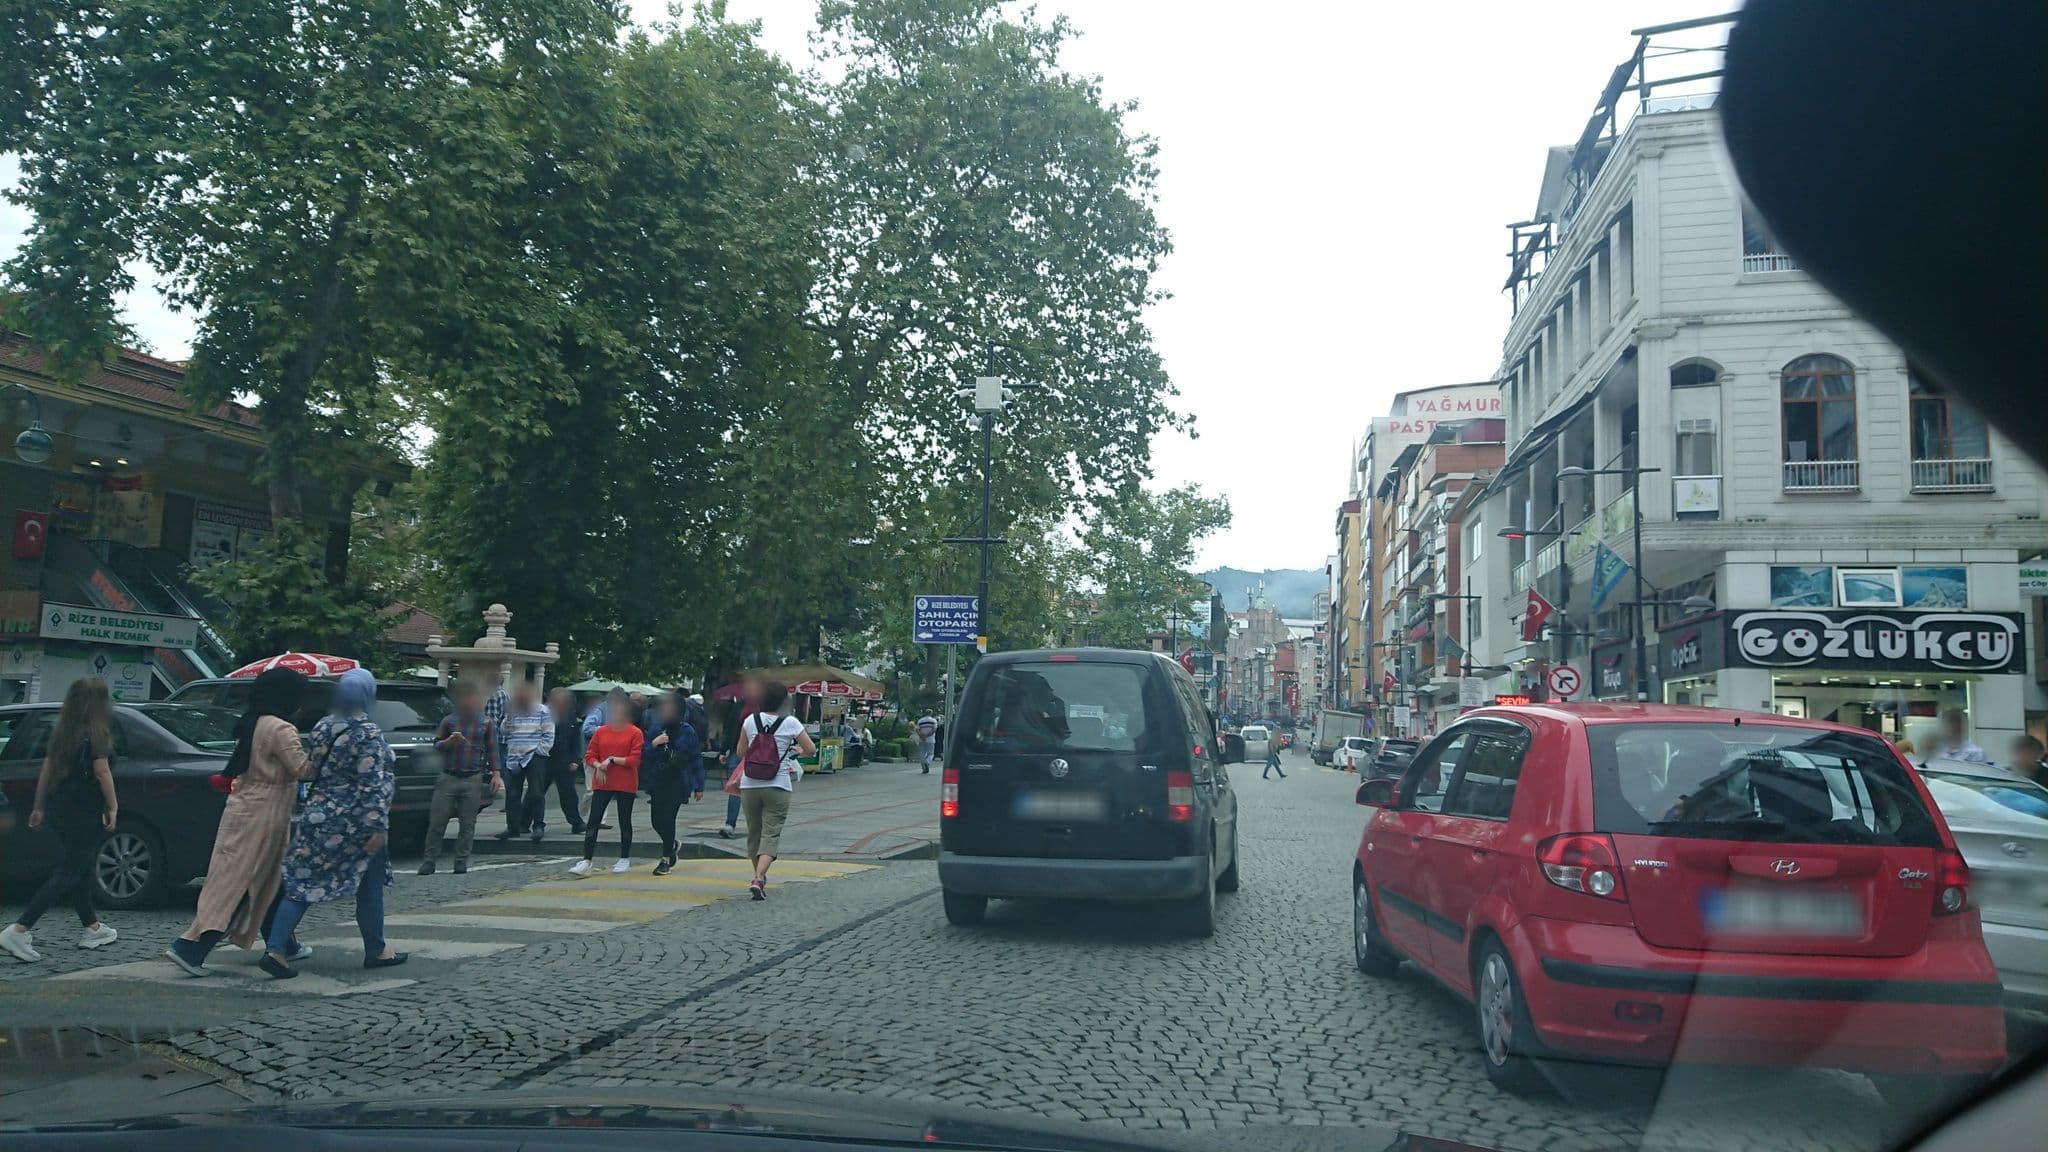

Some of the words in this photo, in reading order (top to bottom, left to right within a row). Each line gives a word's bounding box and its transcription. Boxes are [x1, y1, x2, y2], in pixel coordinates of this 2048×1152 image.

[1416, 395, 1500, 412] YAĞMUR
[68, 613, 96, 625] RİZE
[99, 615, 164, 633] BELEDİYESİ
[80, 627, 111, 639] HALK
[113, 631, 151, 643] EKMEK
[1634, 859, 1669, 867] HYUNDAI
